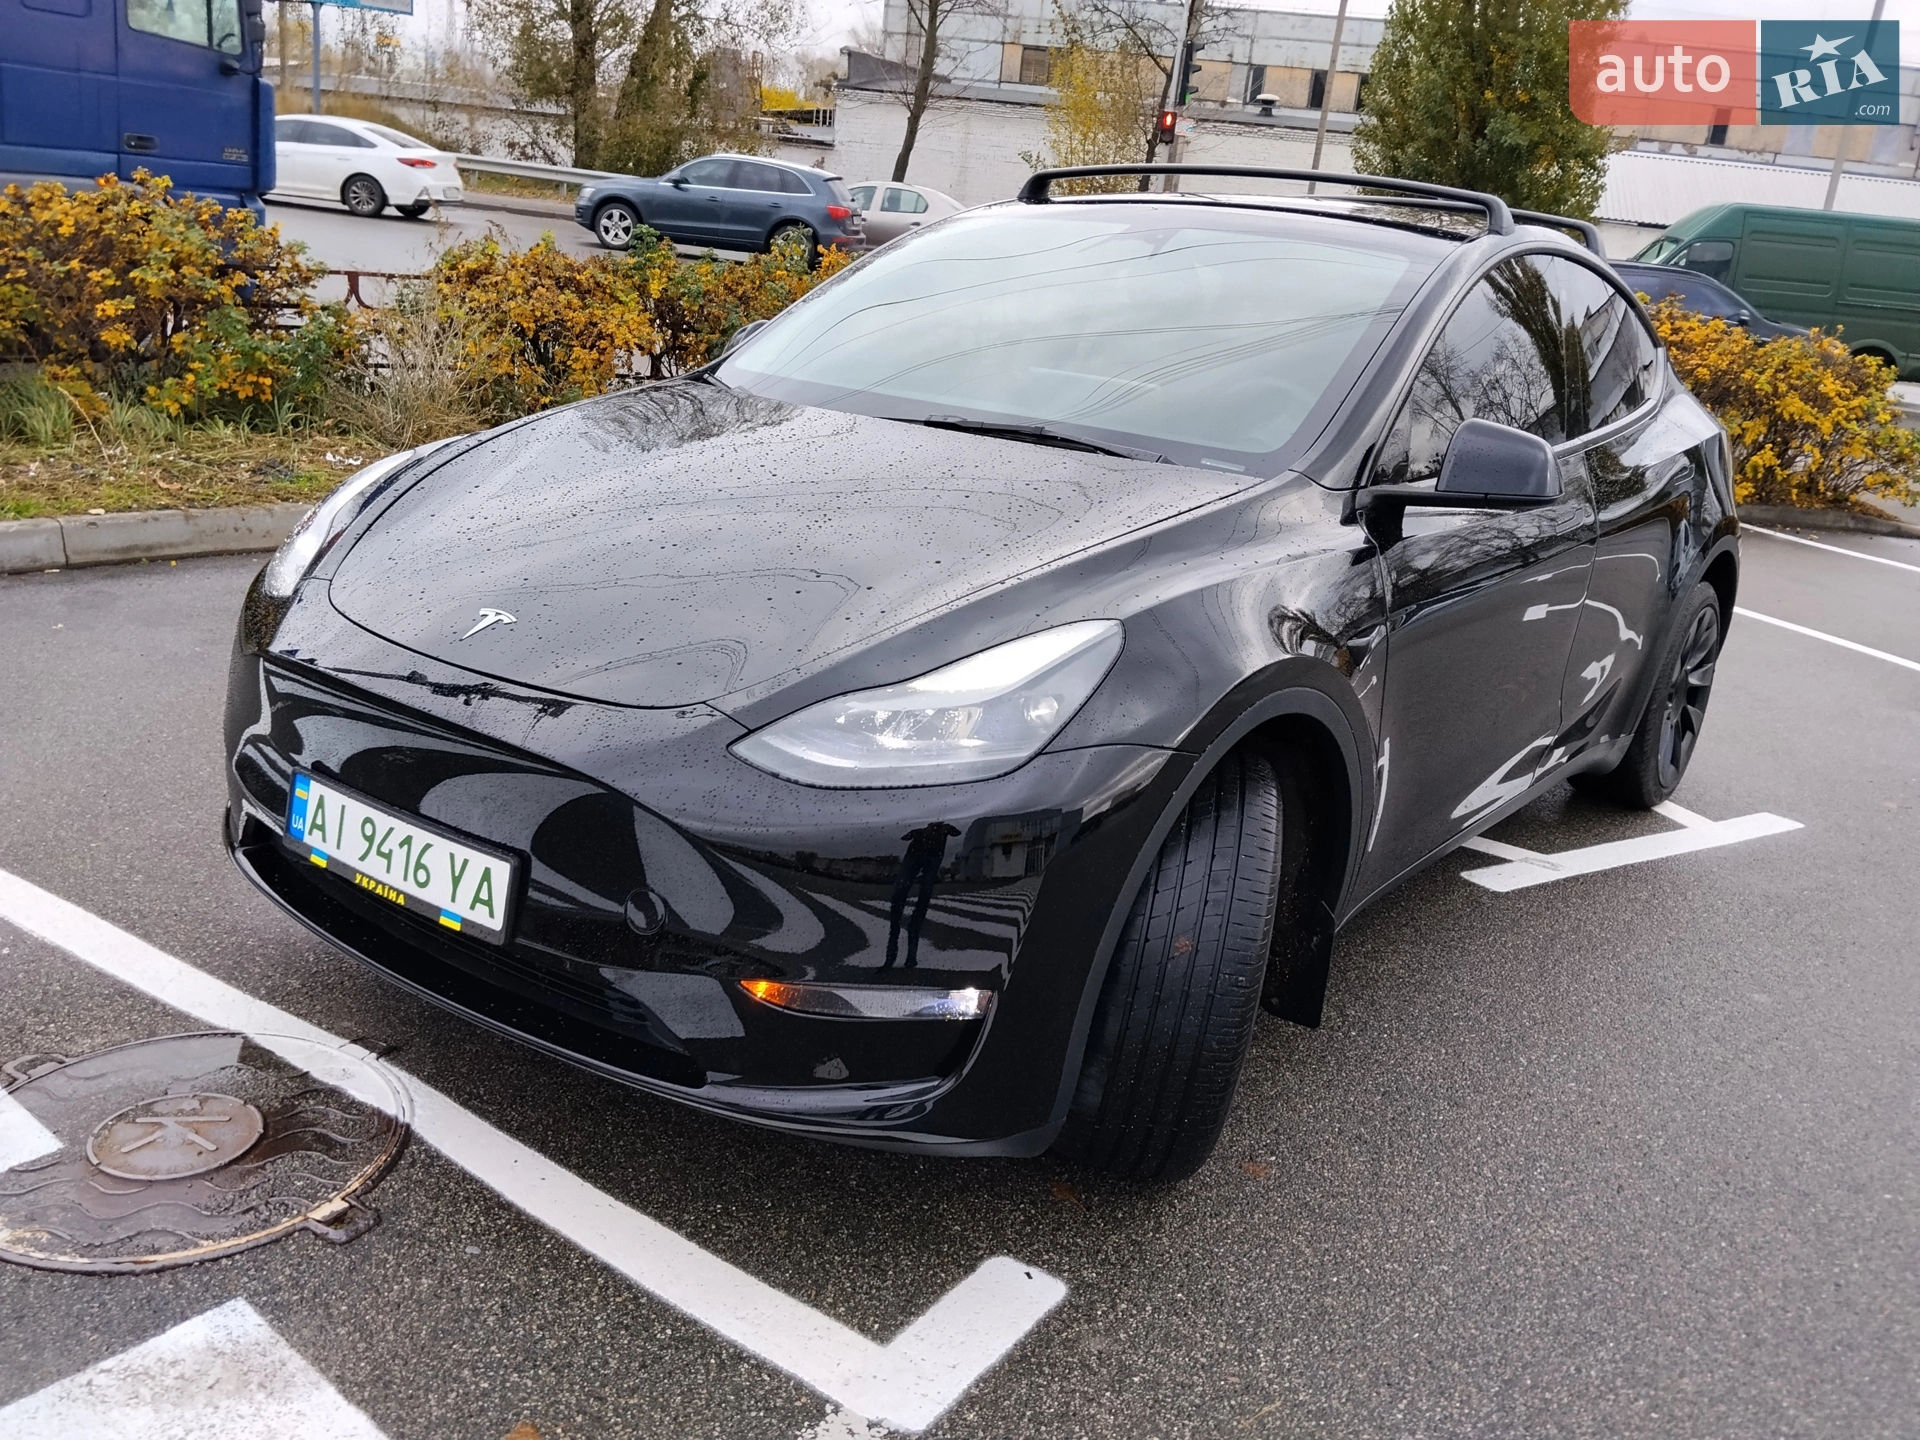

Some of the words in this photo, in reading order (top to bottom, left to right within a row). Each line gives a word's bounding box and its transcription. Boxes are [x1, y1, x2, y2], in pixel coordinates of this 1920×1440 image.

[292, 813, 304, 832] UA
[307, 793, 346, 850] AI
[358, 816, 434, 889] 9416
[449, 852, 495, 919] YA
[355, 872, 405, 906] УКРАЇНА
